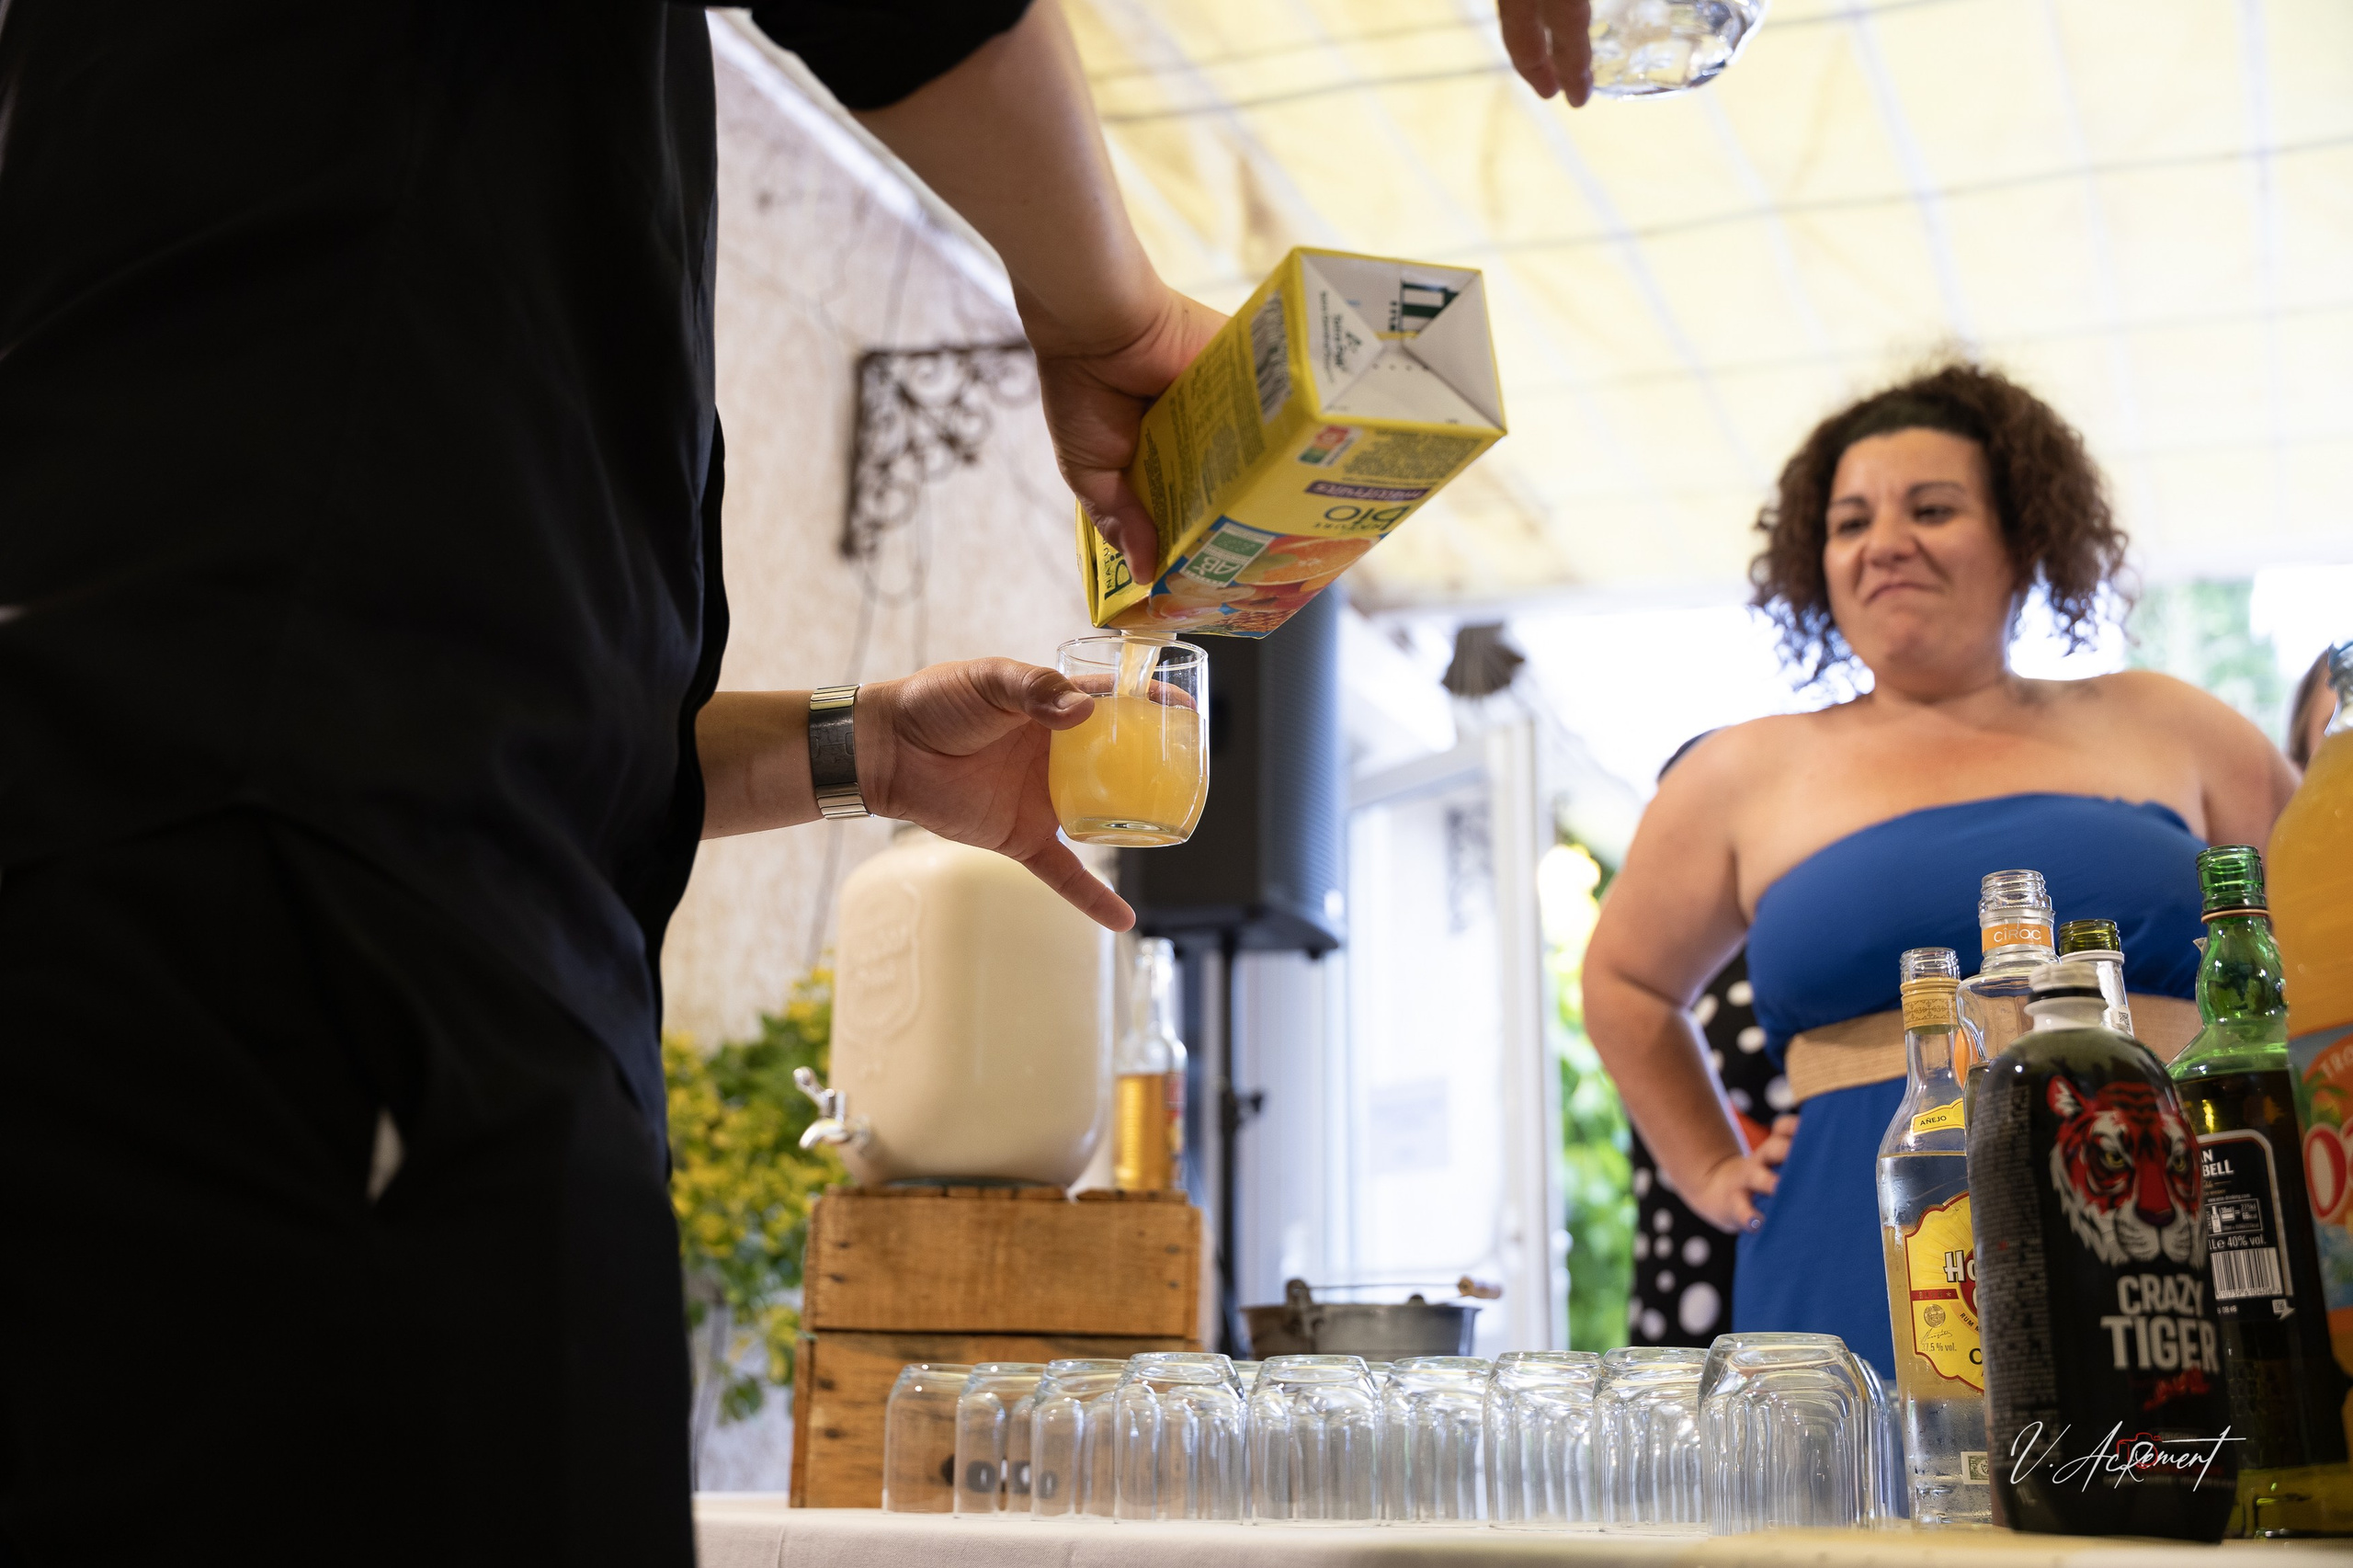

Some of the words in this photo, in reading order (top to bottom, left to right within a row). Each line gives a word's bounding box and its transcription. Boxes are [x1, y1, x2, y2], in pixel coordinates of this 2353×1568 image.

[1324, 505, 1411, 531] bio
[1201, 556, 1240, 574] AB
[1104, 552, 1133, 600] bi
[1919, 1115, 1947, 1126] AÑEJO
[2202, 1159, 2234, 1176] BELL
[2227, 1235, 2247, 1247] 40%
[2249, 1233, 2267, 1245] vol.
[2117, 1273, 2204, 1317] CRAZY
[1960, 1312, 1974, 1327] RUM
[1945, 1342, 1957, 1351] vol.
[2099, 1315, 2221, 1374] TIGER
